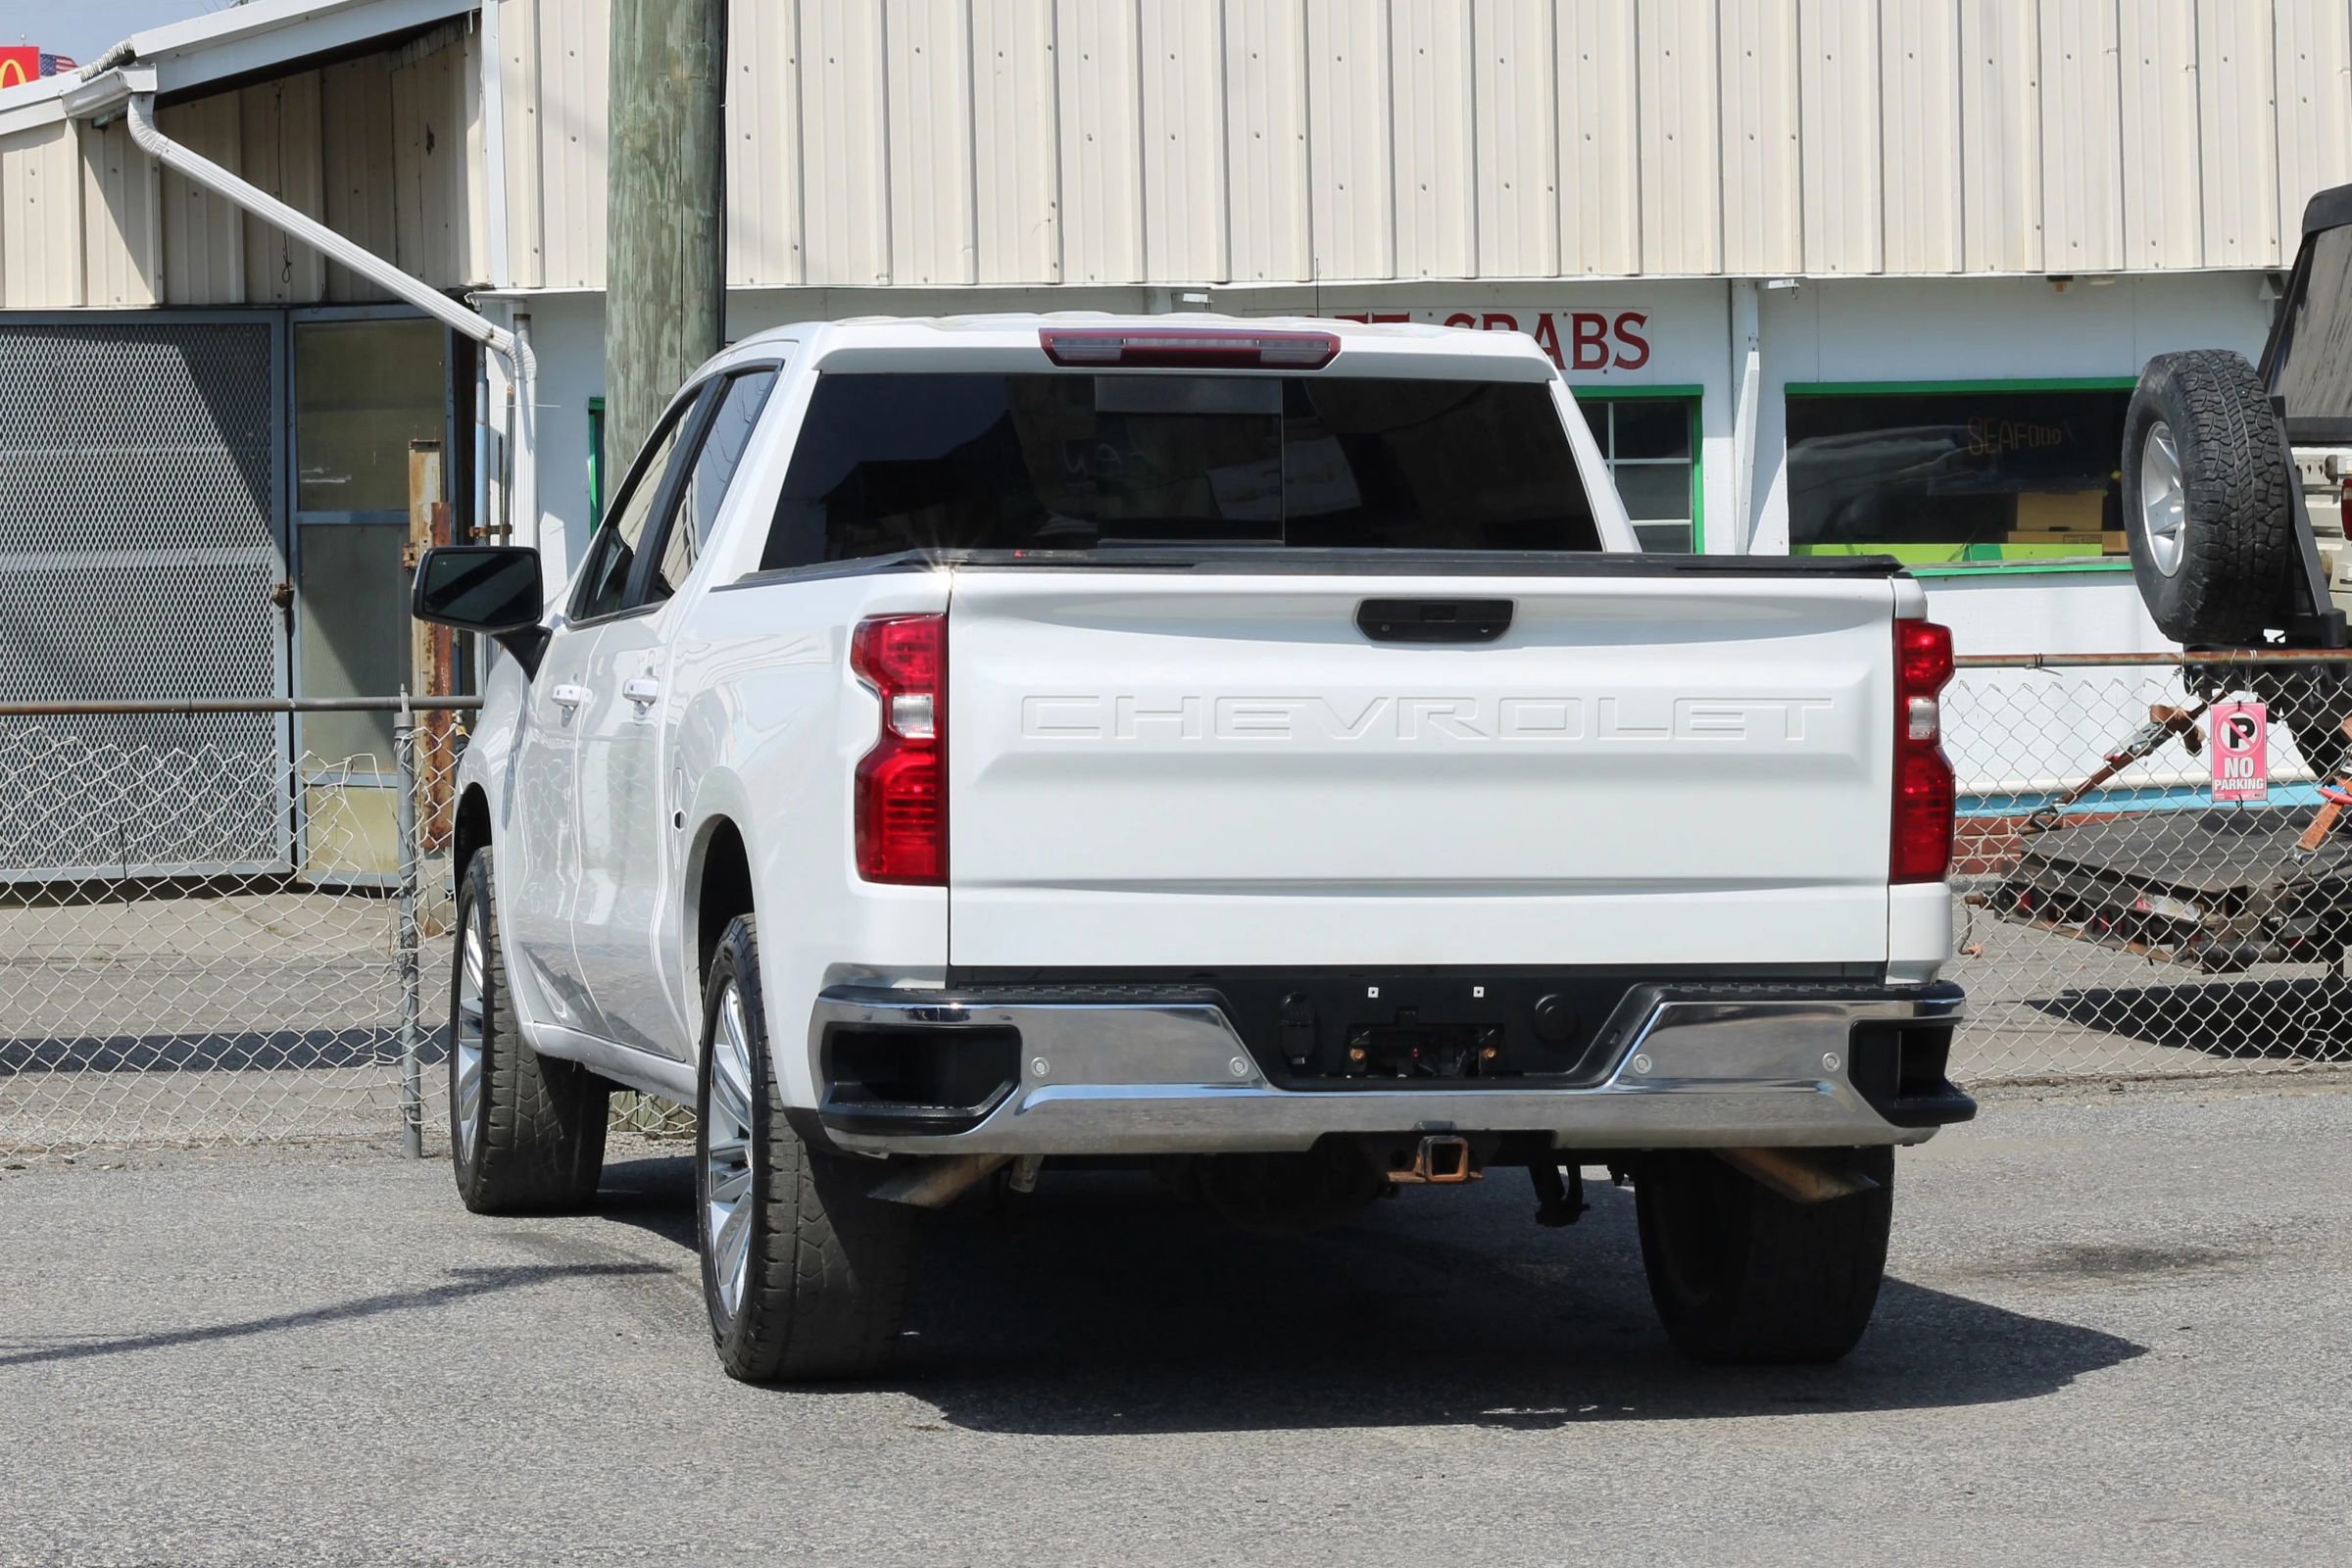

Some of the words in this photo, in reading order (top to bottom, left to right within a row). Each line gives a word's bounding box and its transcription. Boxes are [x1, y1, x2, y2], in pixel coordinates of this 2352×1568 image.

[1443, 311, 1651, 370] ABS
[1967, 416, 2062, 456] SEAFOOD
[1020, 696, 1834, 741] CHEVROLET
[2214, 778, 2265, 791] PARKING
[2224, 757, 2255, 778] NO
